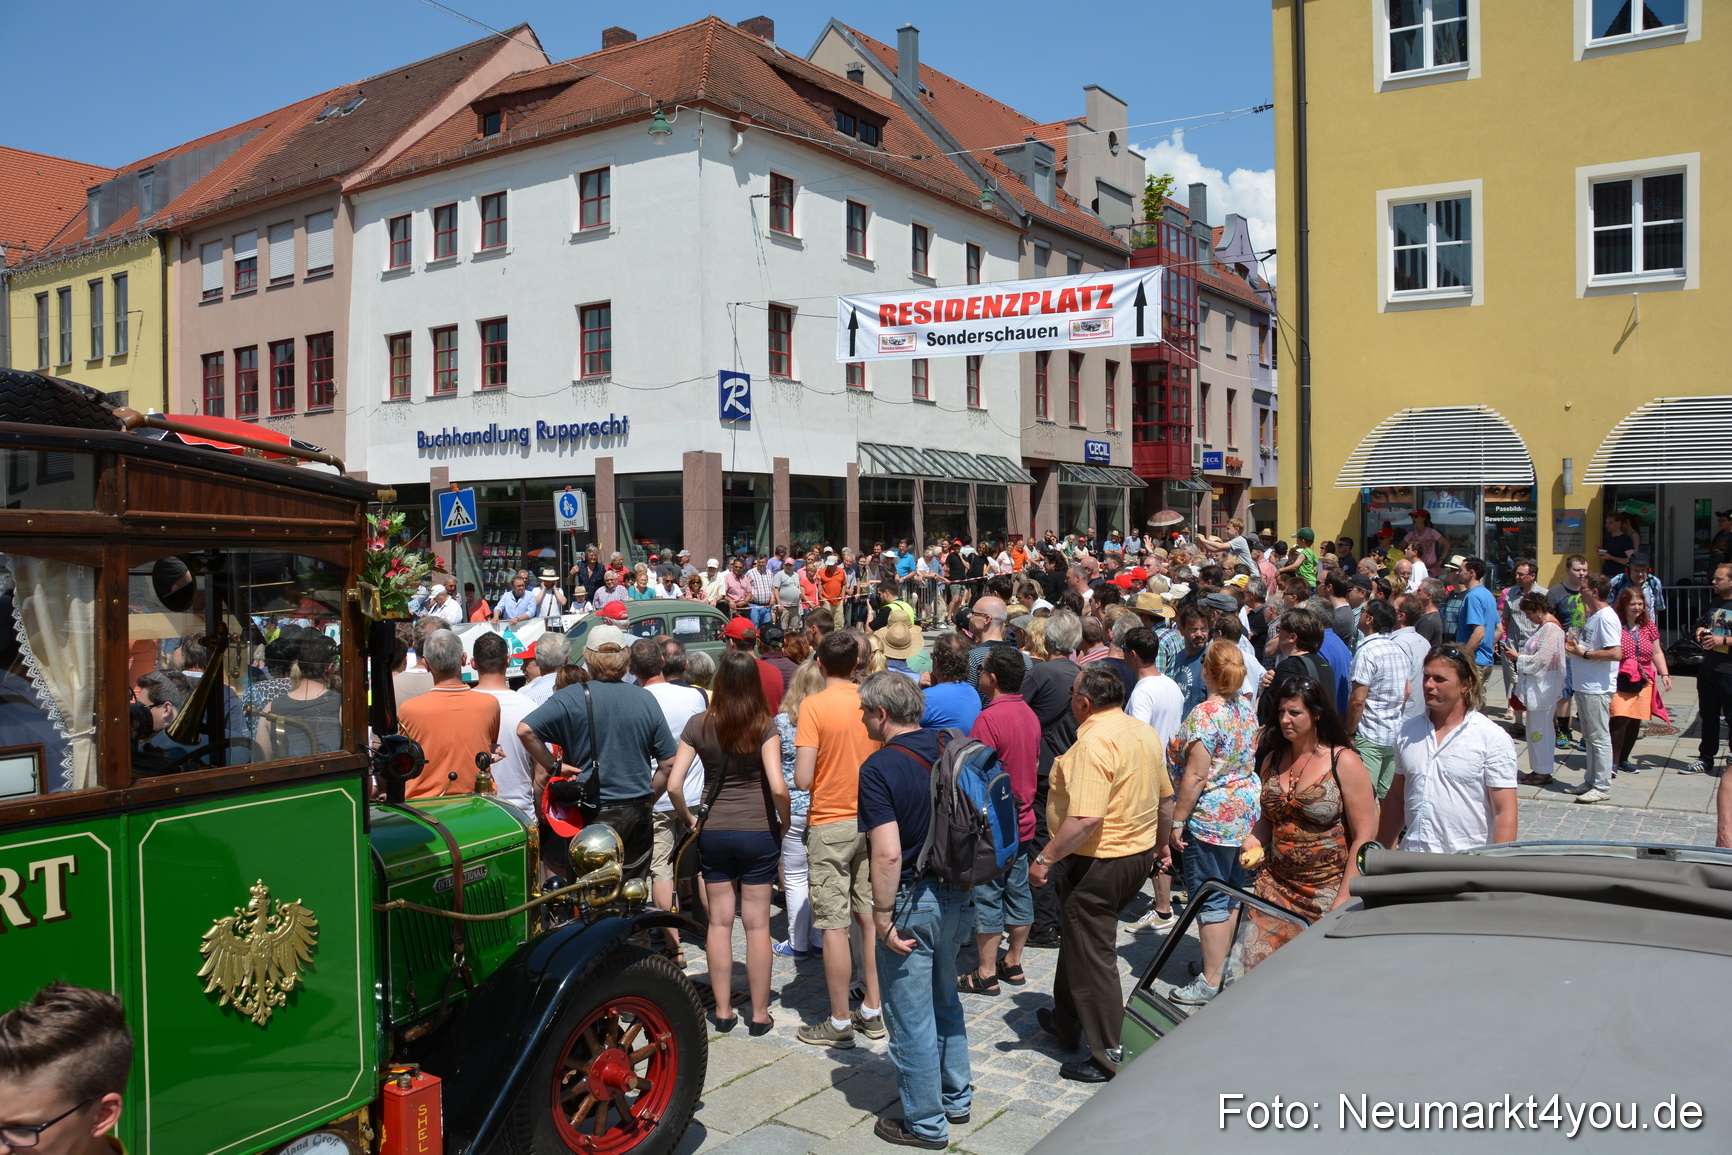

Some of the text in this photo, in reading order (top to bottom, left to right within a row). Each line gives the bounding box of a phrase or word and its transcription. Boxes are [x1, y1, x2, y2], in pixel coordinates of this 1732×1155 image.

[879, 284, 1115, 328] RESIDENZPLATZ
[926, 326, 1059, 347] Sonderschauen
[417, 413, 629, 447] Buchhandlung Rupprecht
[1088, 442, 1110, 456] CECIL
[437, 866, 485, 891] INTETIONAL
[284, 1138, 309, 1155] land
